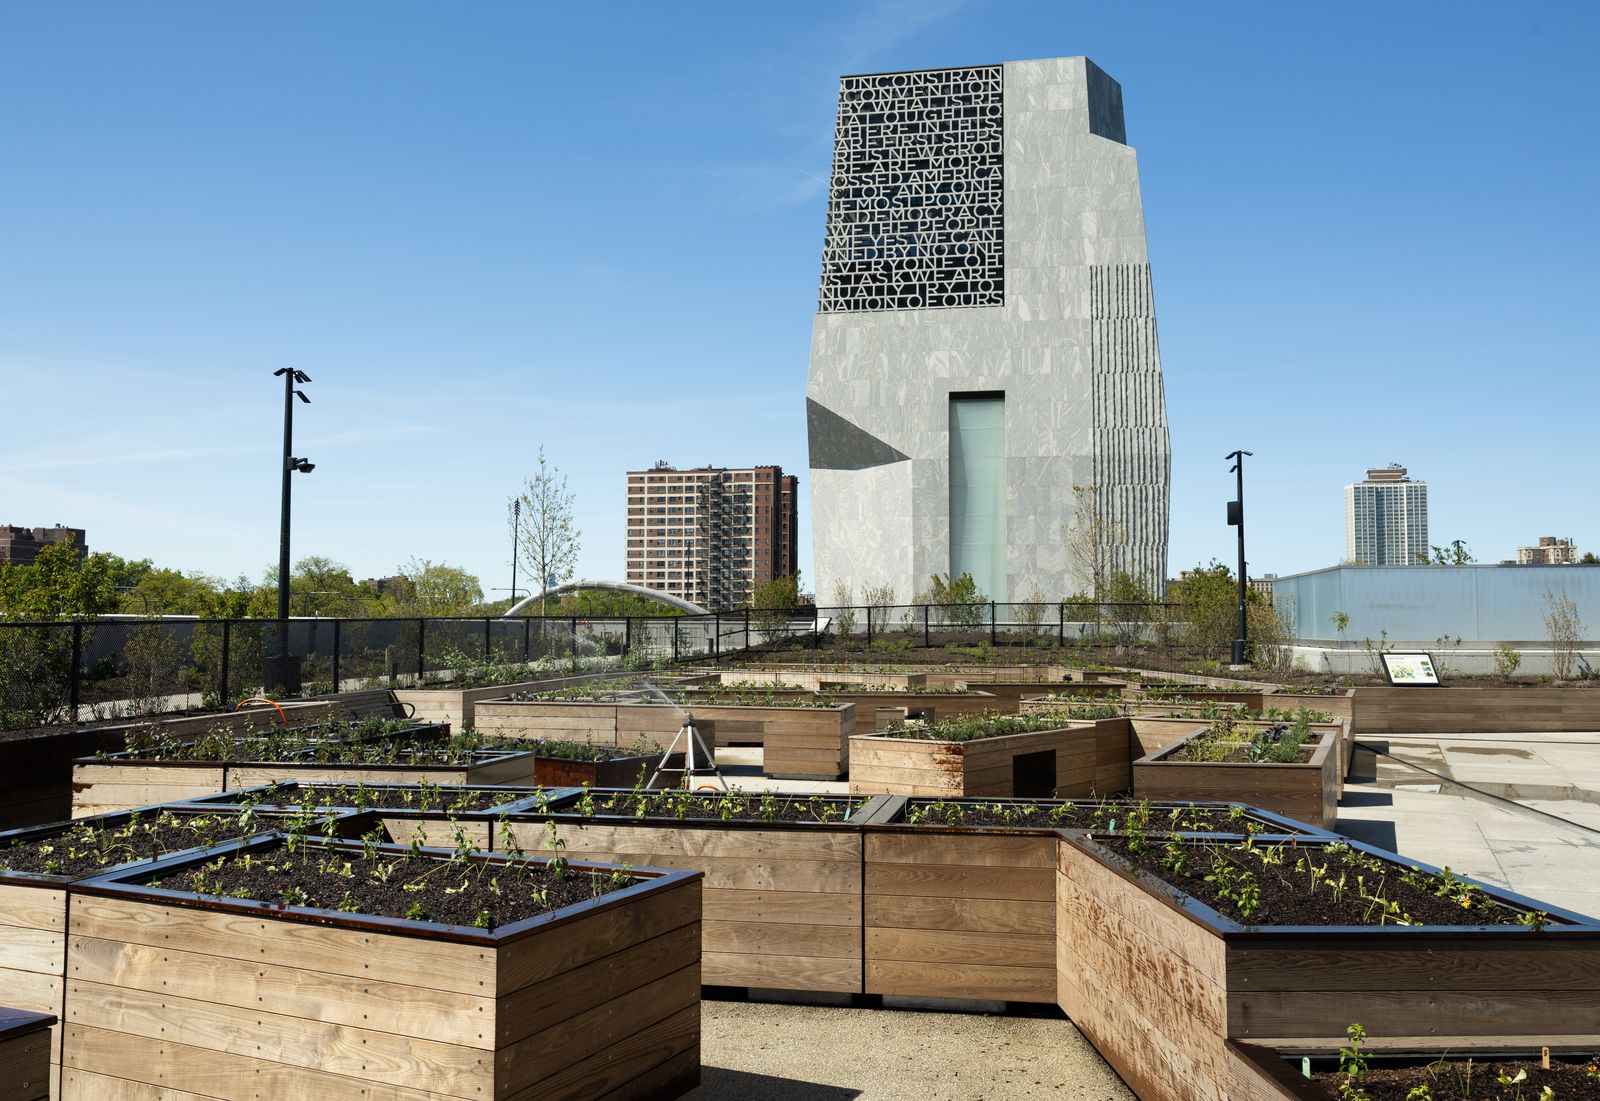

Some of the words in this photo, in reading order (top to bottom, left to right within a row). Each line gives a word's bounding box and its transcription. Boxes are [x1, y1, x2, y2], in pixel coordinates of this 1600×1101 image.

[843, 66, 1002, 92] UNCONSTRAIN
[844, 79, 1001, 103] CONVENTION
[840, 100, 866, 116] BY
[872, 96, 934, 114] WHAT
[945, 94, 963, 109] IS
[884, 106, 967, 125] OUGHT
[974, 103, 1002, 119] TO
[919, 119, 939, 135] IN
[946, 115, 997, 133] THIS
[837, 136, 881, 152] ARE
[884, 132, 938, 149] FIRST
[943, 128, 1001, 146] STEPS
[872, 158, 917, 174] ARE
[930, 153, 998, 171] MORE
[889, 145, 937, 161] NEW
[908, 165, 1002, 185] AMERICA
[862, 184, 890, 199] OF
[897, 181, 943, 197] ANY
[952, 178, 1000, 194] ONE
[857, 195, 914, 212] MOST
[857, 202, 1002, 224] DEMOCRACY
[829, 222, 862, 238] WE
[867, 220, 909, 236] THE
[918, 215, 1001, 234] PEOPLE
[871, 232, 907, 248] YES
[914, 231, 947, 246] WE
[951, 228, 997, 244] CAN
[885, 244, 913, 260] BY
[916, 243, 948, 258] NO
[955, 240, 1001, 256] ONE
[827, 255, 954, 275] EVERYONE
[965, 253, 999, 268] OH
[848, 270, 903, 286] TASK
[910, 268, 945, 284] WE
[953, 265, 997, 282] ARE
[913, 280, 955, 296] TRY
[964, 278, 994, 294] TO
[907, 294, 937, 310] OF
[943, 290, 1003, 309] OURS
